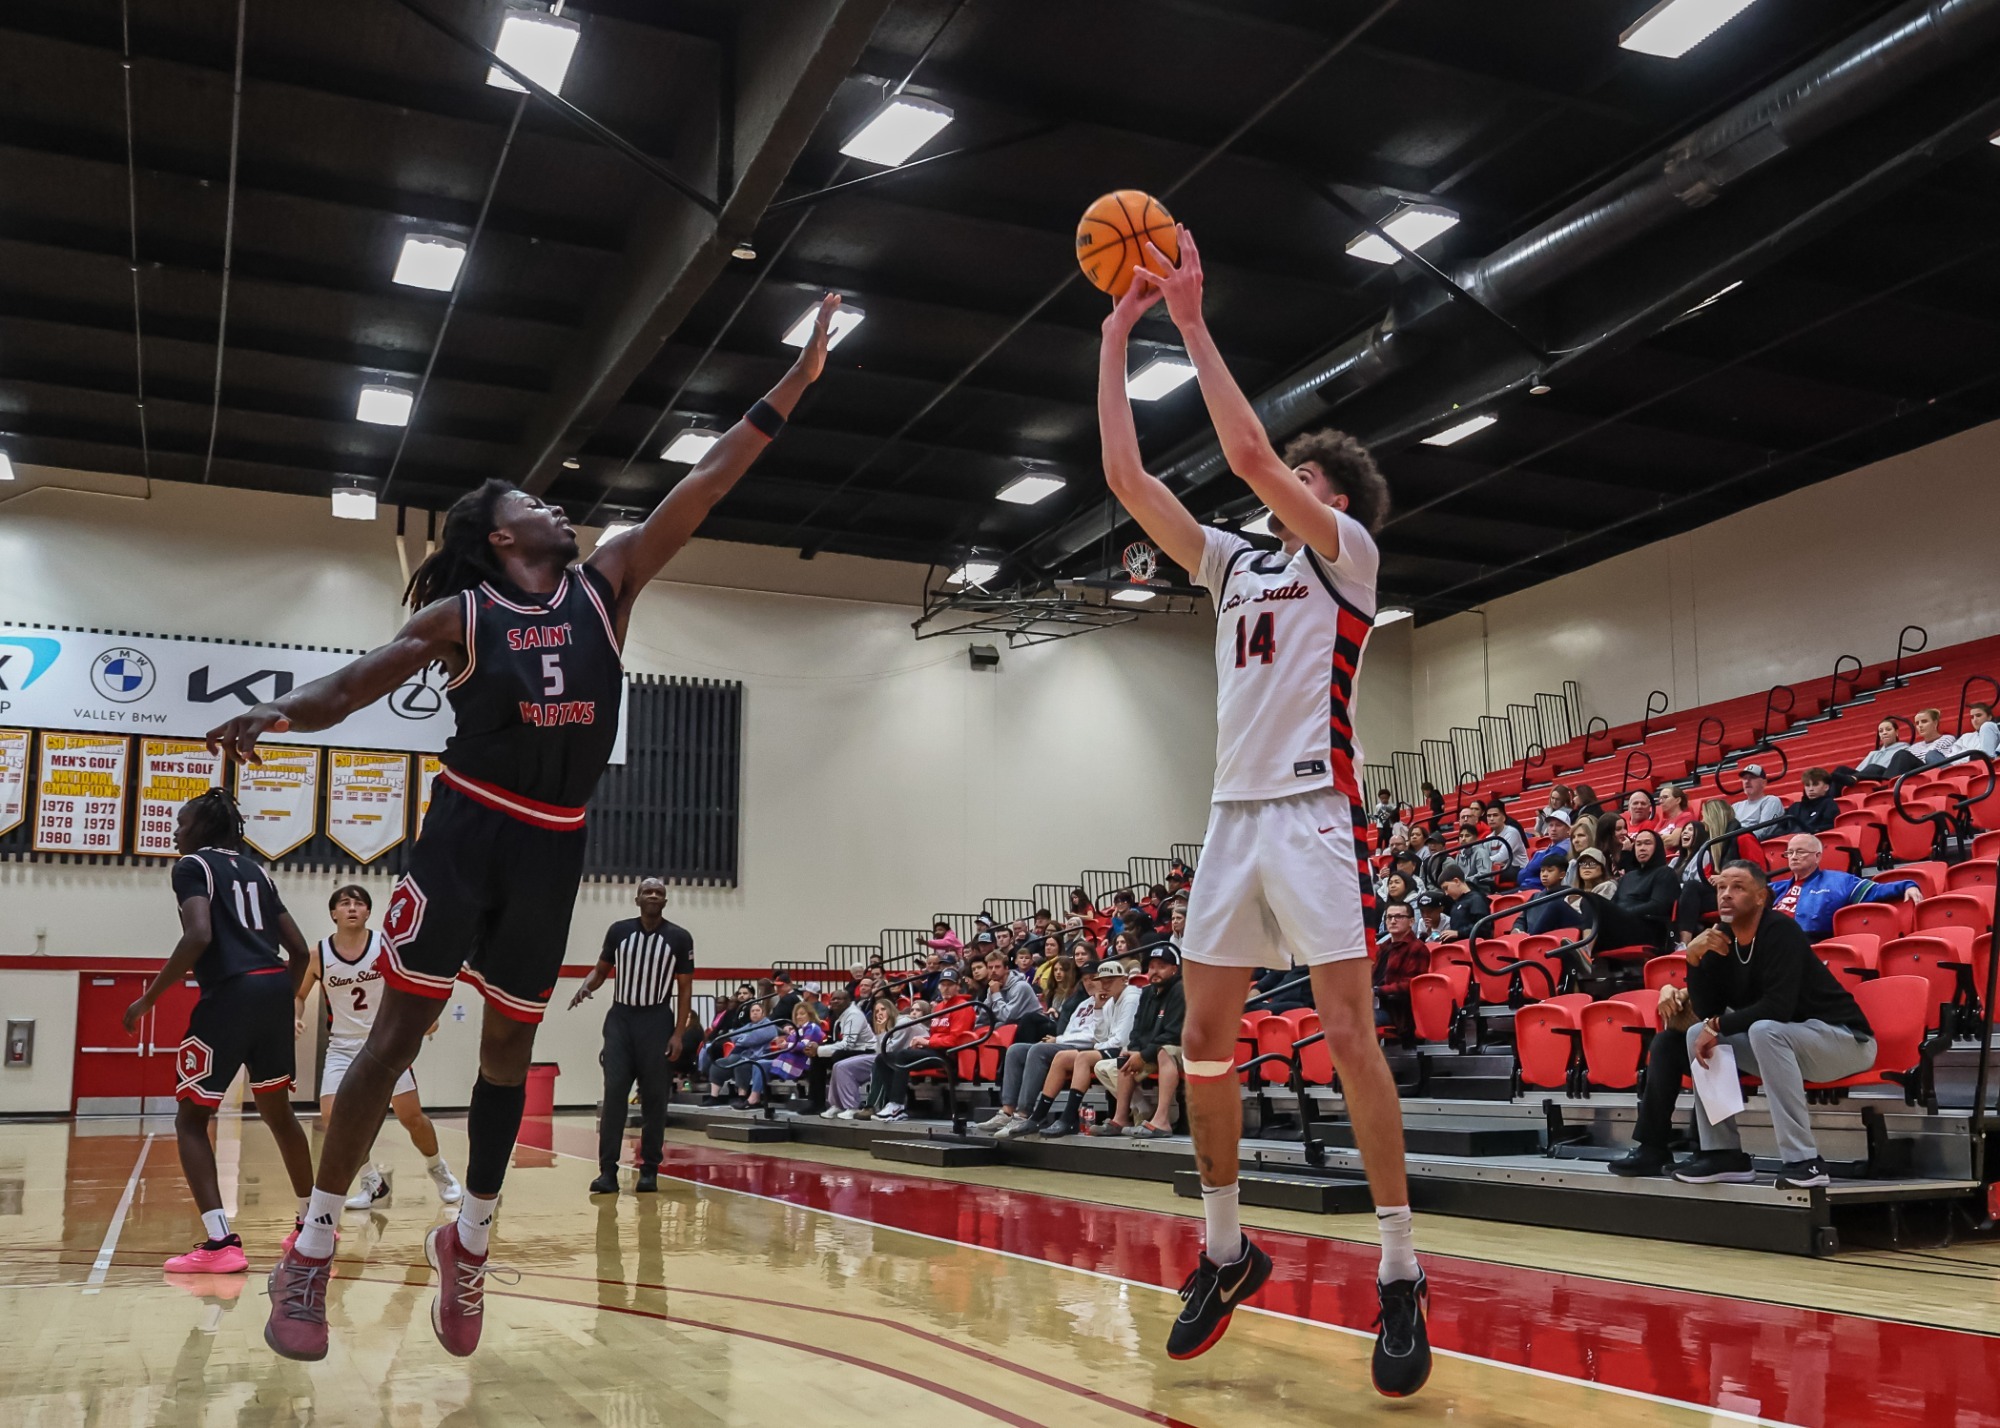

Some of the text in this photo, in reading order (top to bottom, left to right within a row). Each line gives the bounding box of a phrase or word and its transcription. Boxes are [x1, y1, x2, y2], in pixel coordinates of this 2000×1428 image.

[1235, 611, 1276, 668] 14
[101, 650, 148, 667] BMW
[541, 654, 565, 696] 5
[74, 708, 168, 723] VALLEY BMW
[51, 755, 118, 769] MEN'S GOLF
[150, 761, 214, 774] MEN'S GOLF
[51, 769, 113, 785] NATIONAL
[241, 769, 315, 785] CHAMPIONS
[332, 774, 404, 790] CHAMPIONS
[43, 781, 121, 798] CHAMPIONS
[42, 800, 74, 812] 1976
[84, 802, 116, 814] 1977
[142, 804, 173, 817] 1984
[40, 815, 73, 828] 1978
[83, 818, 115, 830] 1979
[141, 820, 172, 833] 1986
[39, 831, 72, 844] 1980
[82, 834, 111, 846] 1981
[140, 835, 171, 848] 1988
[231, 880, 263, 930] 11
[328, 975, 355, 987] Stan
[351, 986, 368, 1011] 2
